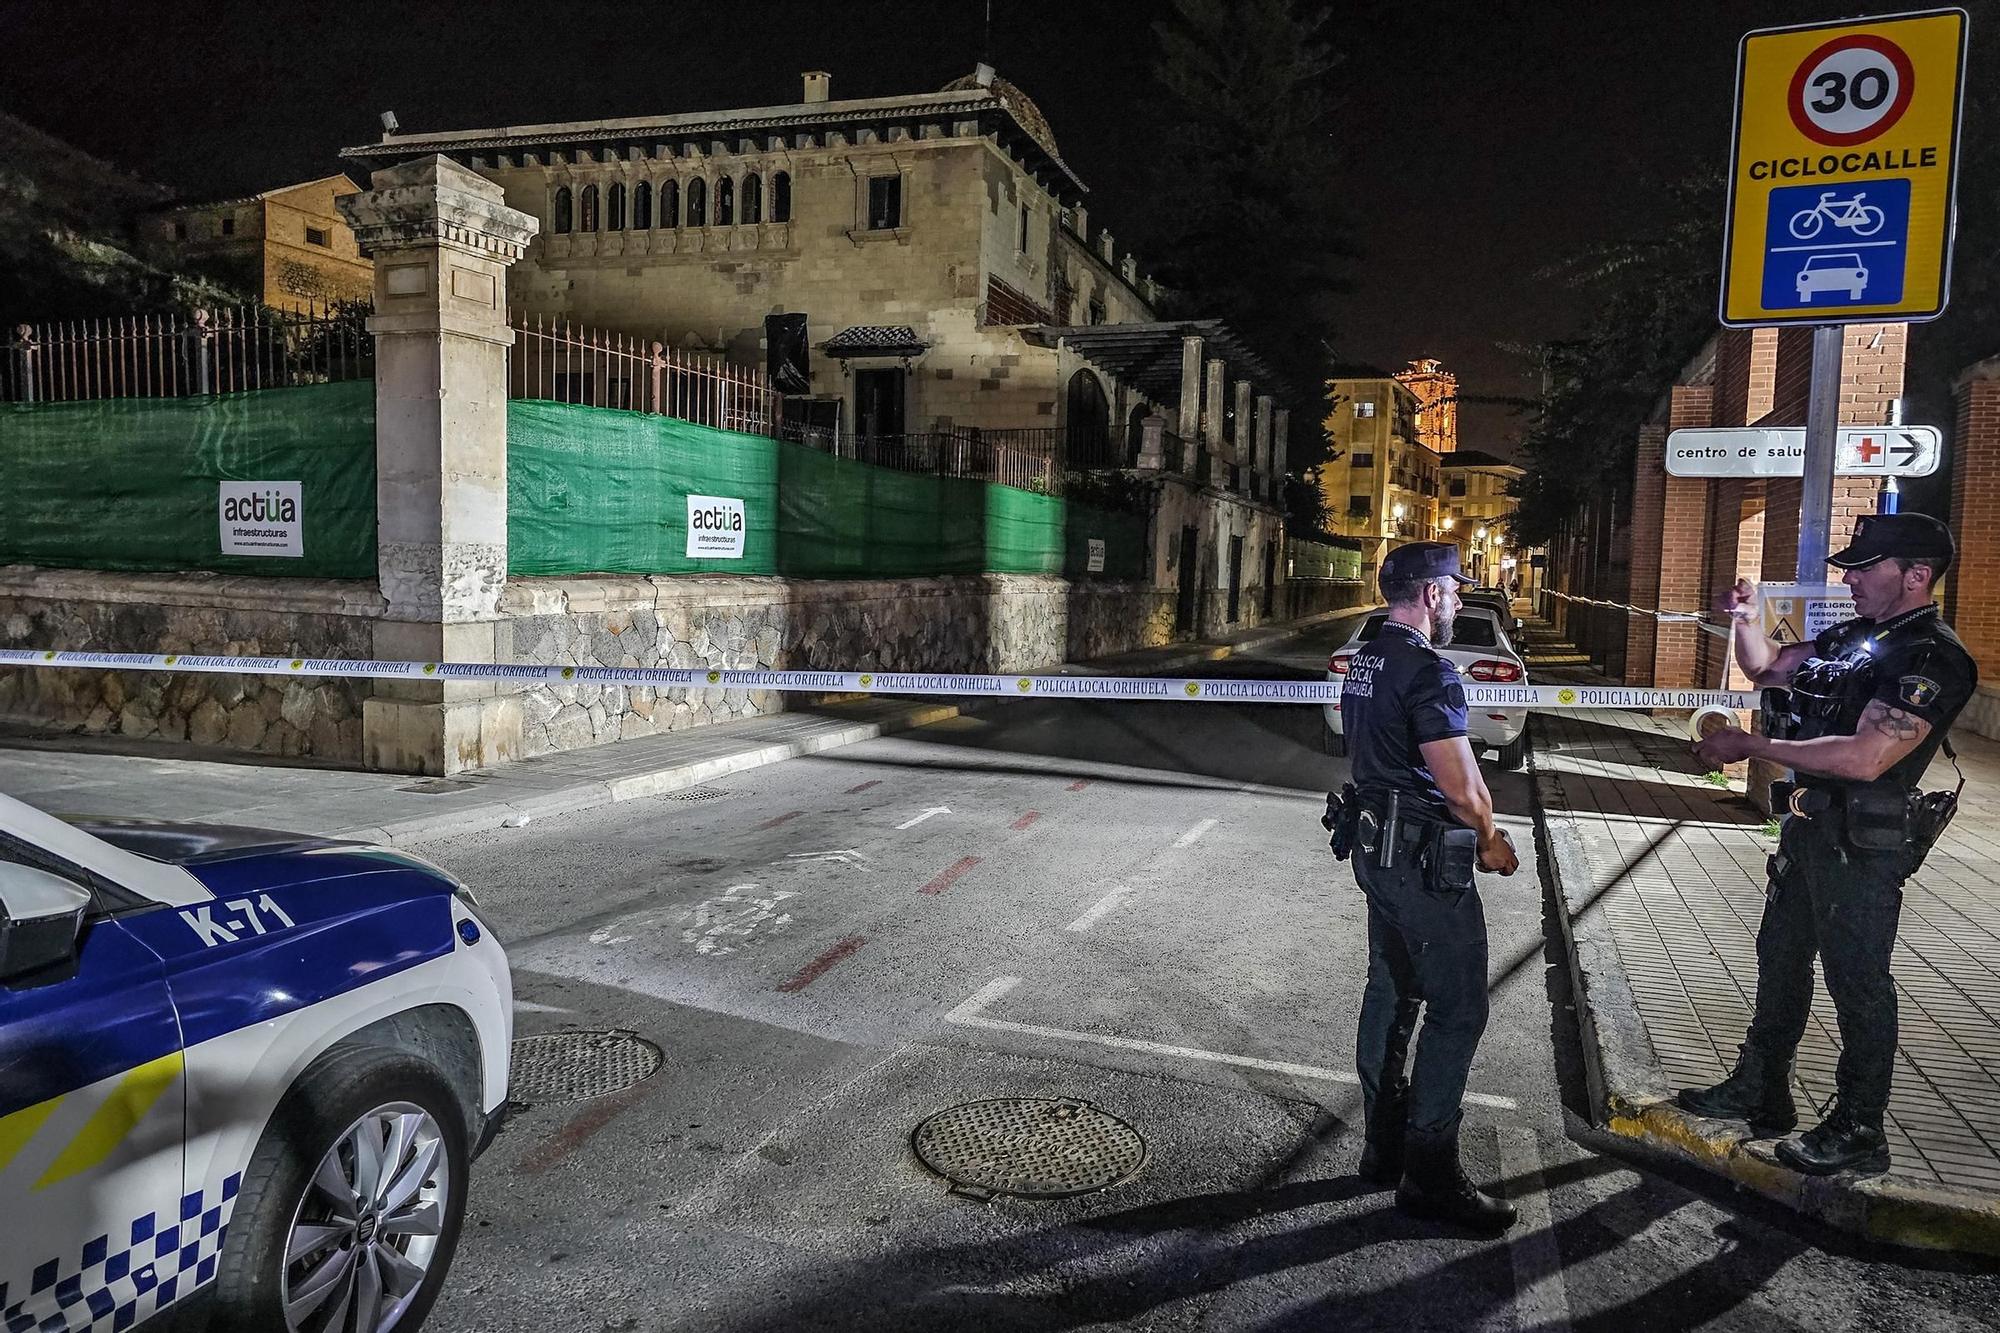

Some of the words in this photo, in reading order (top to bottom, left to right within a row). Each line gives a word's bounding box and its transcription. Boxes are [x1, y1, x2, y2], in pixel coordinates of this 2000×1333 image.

[1810, 67, 1890, 114] 30
[1749, 147, 1937, 180] CICLOCALLE
[1677, 447, 1727, 458] centro
[1738, 447, 1757, 457] de
[224, 490, 296, 522] actüa
[693, 505, 742, 531] actüa
[233, 527, 288, 538] infraestructuras
[178, 656, 210, 666] POLICIA
[210, 657, 237, 667] LOCAL
[237, 659, 279, 669] ORIHUELA
[304, 660, 339, 670] POLICIA
[339, 661, 366, 671] LOCAL
[366, 662, 410, 673] ORIHUELA
[1350, 654, 1385, 671] OLICIA
[438, 664, 472, 675] POLICIA
[474, 665, 501, 676] LOCAL
[503, 666, 548, 677] ORIHUELA
[577, 668, 613, 680] POLICIA
[614, 669, 644, 680] LOCAL
[645, 670, 692, 682] ORIHUELA
[1347, 668, 1373, 683] LOCAL
[723, 672, 761, 684] POLICIA
[763, 673, 793, 685] LOCAL
[795, 674, 844, 686] ORIHUELA
[876, 675, 915, 689] POLICIA
[917, 676, 949, 689] LOCAL
[951, 677, 1001, 691] ORIHUELA
[1035, 679, 1078, 693] POLICIA
[1078, 680, 1111, 693] LOCAL
[1113, 681, 1168, 695] ORIHUELA
[1204, 684, 1249, 697] POLICIA
[1251, 684, 1286, 698] LOCAL
[1289, 685, 1340, 699] ORIHUEL
[1476, 688, 1539, 703] ORIHUELA
[1581, 691, 1631, 705] POLICIA
[1635, 692, 1675, 706] LOCAL
[178, 894, 295, 947] K-71
